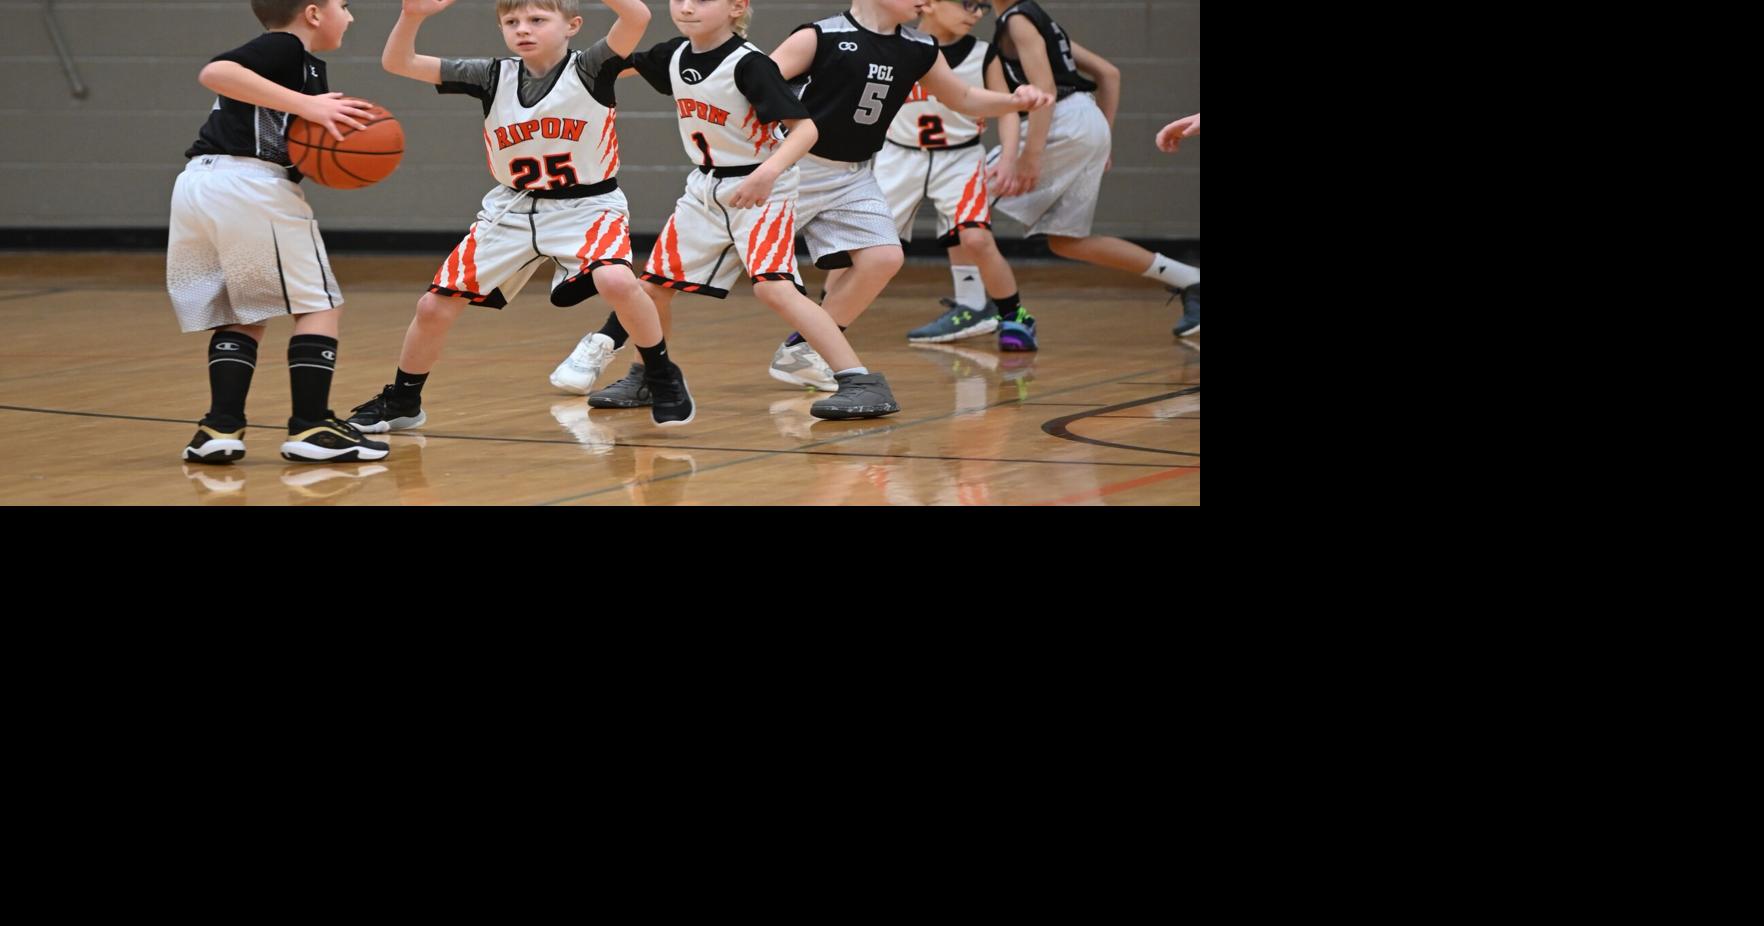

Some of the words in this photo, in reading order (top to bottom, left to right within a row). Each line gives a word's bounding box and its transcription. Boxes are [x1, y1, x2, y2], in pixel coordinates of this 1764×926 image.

[867, 64, 893, 81] PGL
[677, 98, 731, 127] IPON
[853, 82, 890, 125] 5
[494, 117, 588, 150] RIPON
[917, 114, 948, 147] 2
[690, 130, 714, 167] 1
[509, 152, 579, 190] 25
